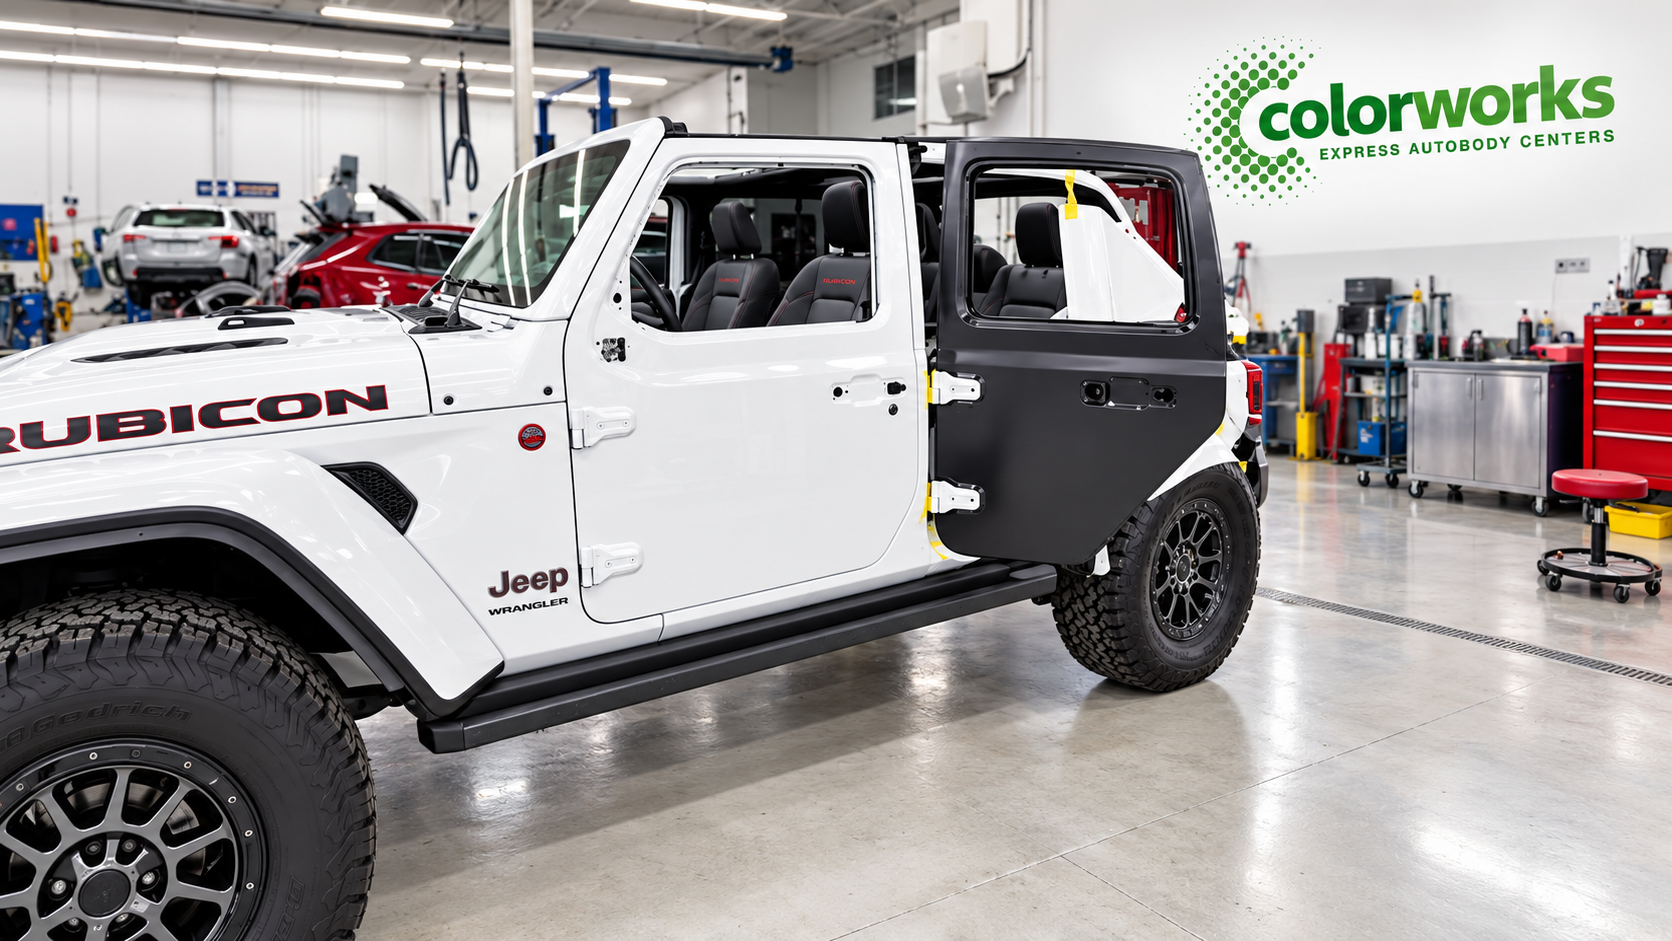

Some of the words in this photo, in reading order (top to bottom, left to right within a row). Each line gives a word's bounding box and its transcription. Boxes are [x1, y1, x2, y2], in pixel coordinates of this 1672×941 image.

[1259, 64, 1616, 142] colorworks
[1319, 144, 1400, 160] EXPRESS
[1409, 136, 1511, 155] AUTOBODY
[1519, 130, 1615, 148] CENTERS
[488, 566, 569, 598] Jeep
[488, 597, 569, 616] WRANGLER
